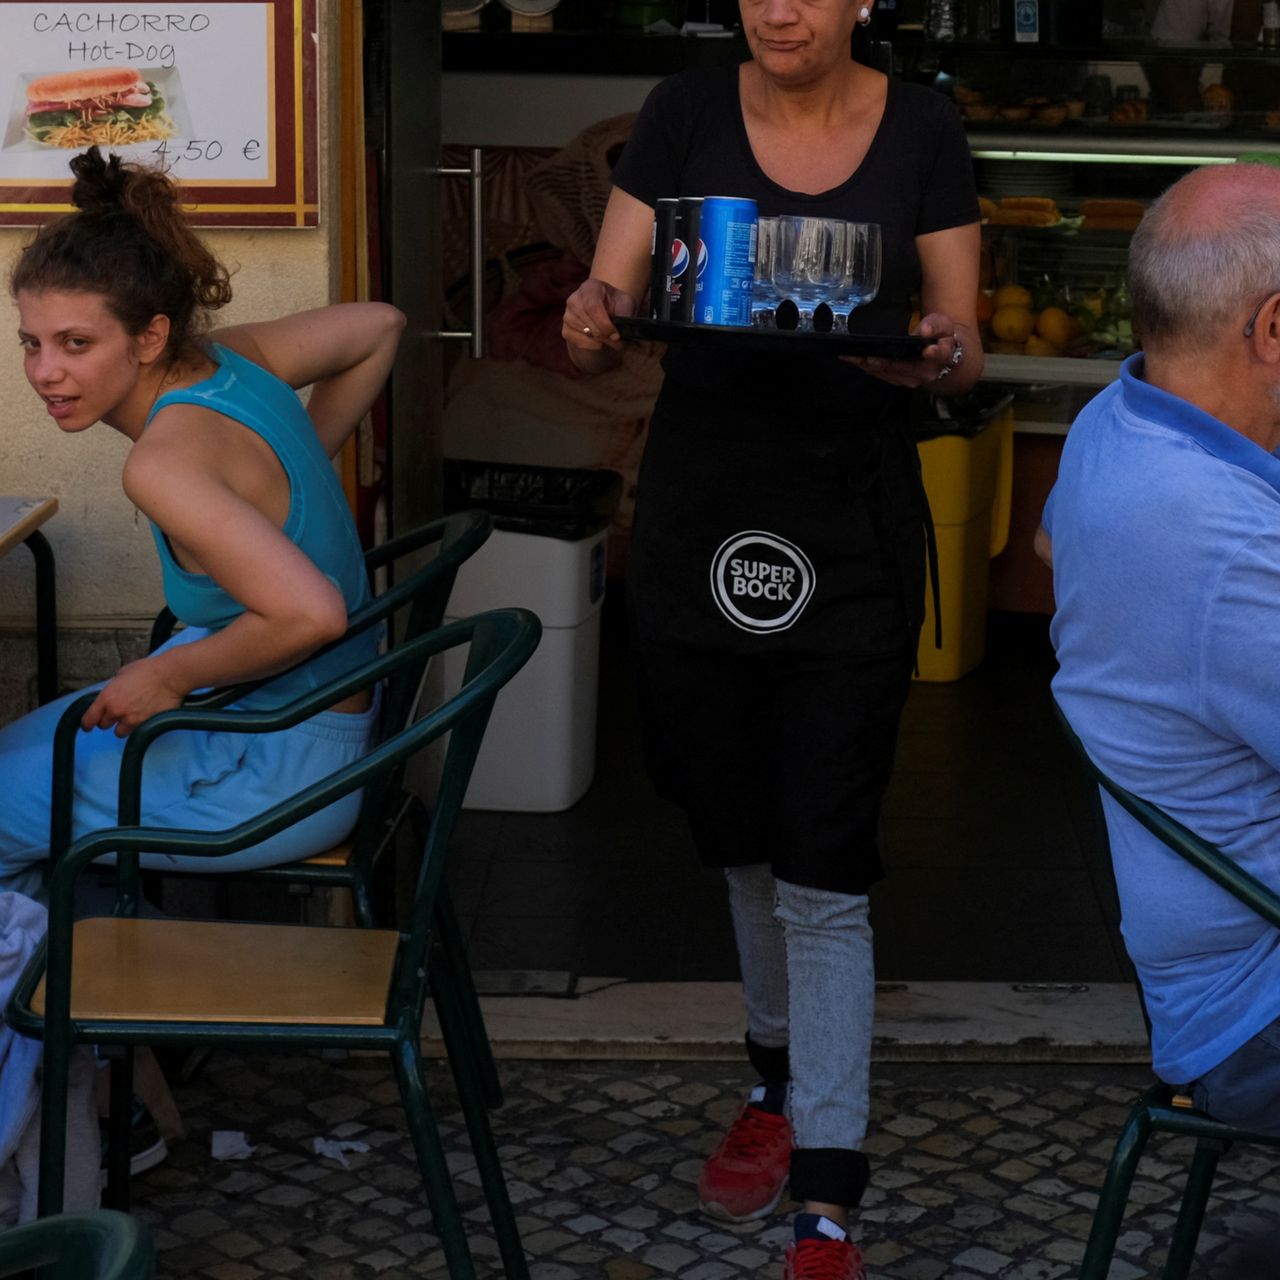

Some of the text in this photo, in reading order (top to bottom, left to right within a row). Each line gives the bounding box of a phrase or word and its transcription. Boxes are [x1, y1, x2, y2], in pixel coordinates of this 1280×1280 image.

[34, 13, 209, 32] CACHORRO
[69, 41, 176, 68] Hot-Dog
[730, 558, 796, 583] SUPER
[733, 577, 793, 601] BOCK
